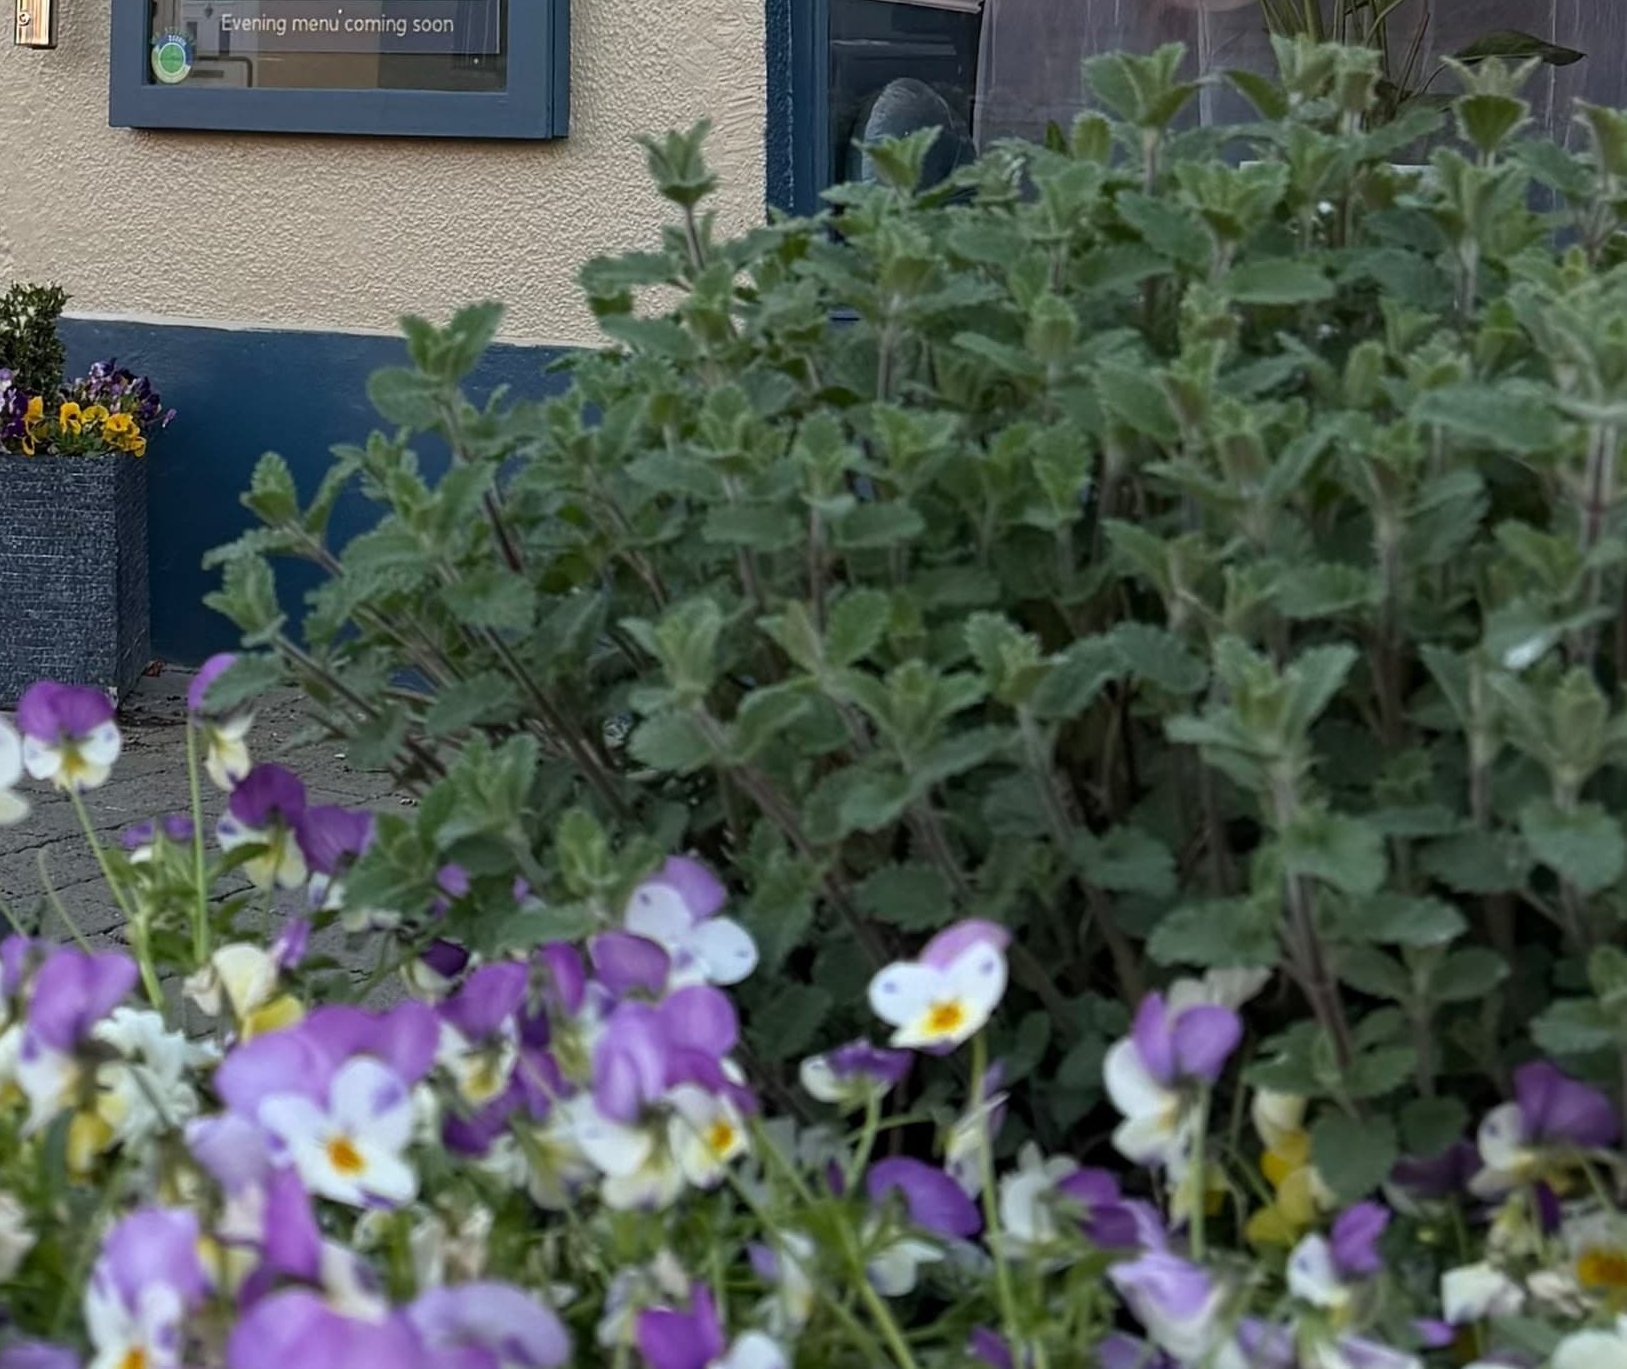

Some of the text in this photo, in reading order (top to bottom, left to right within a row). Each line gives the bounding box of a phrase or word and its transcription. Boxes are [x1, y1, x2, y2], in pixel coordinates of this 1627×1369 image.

[221, 13, 454, 37] Evening menu coming soon
